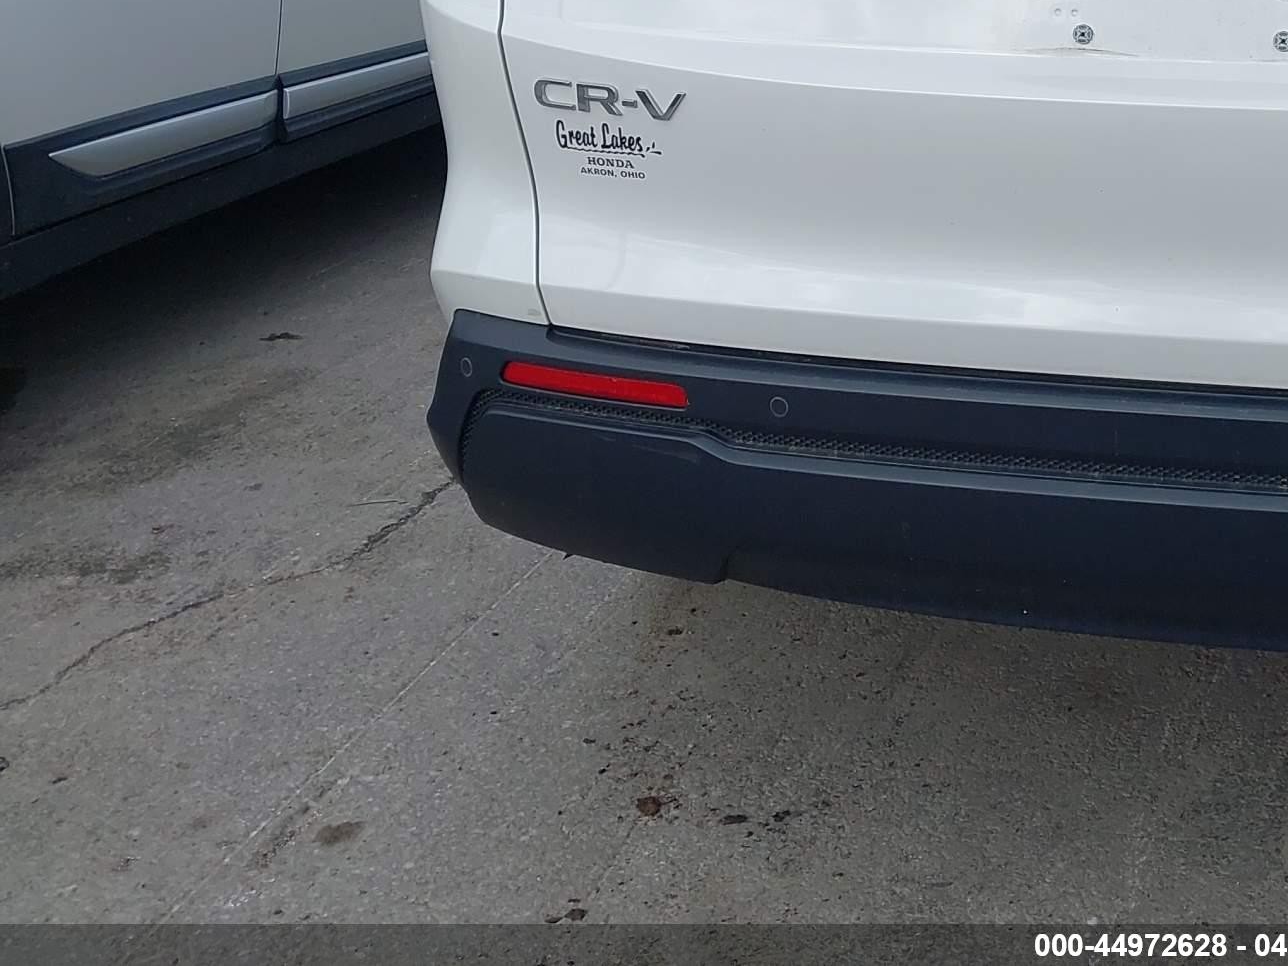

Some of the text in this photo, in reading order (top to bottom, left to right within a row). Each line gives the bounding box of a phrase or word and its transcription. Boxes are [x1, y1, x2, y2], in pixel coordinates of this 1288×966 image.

[533, 76, 687, 122] CR-V
[555, 119, 644, 152] Great Lakes
[580, 166, 646, 180] AKRON, OHIO
[587, 156, 635, 169] HONDA
